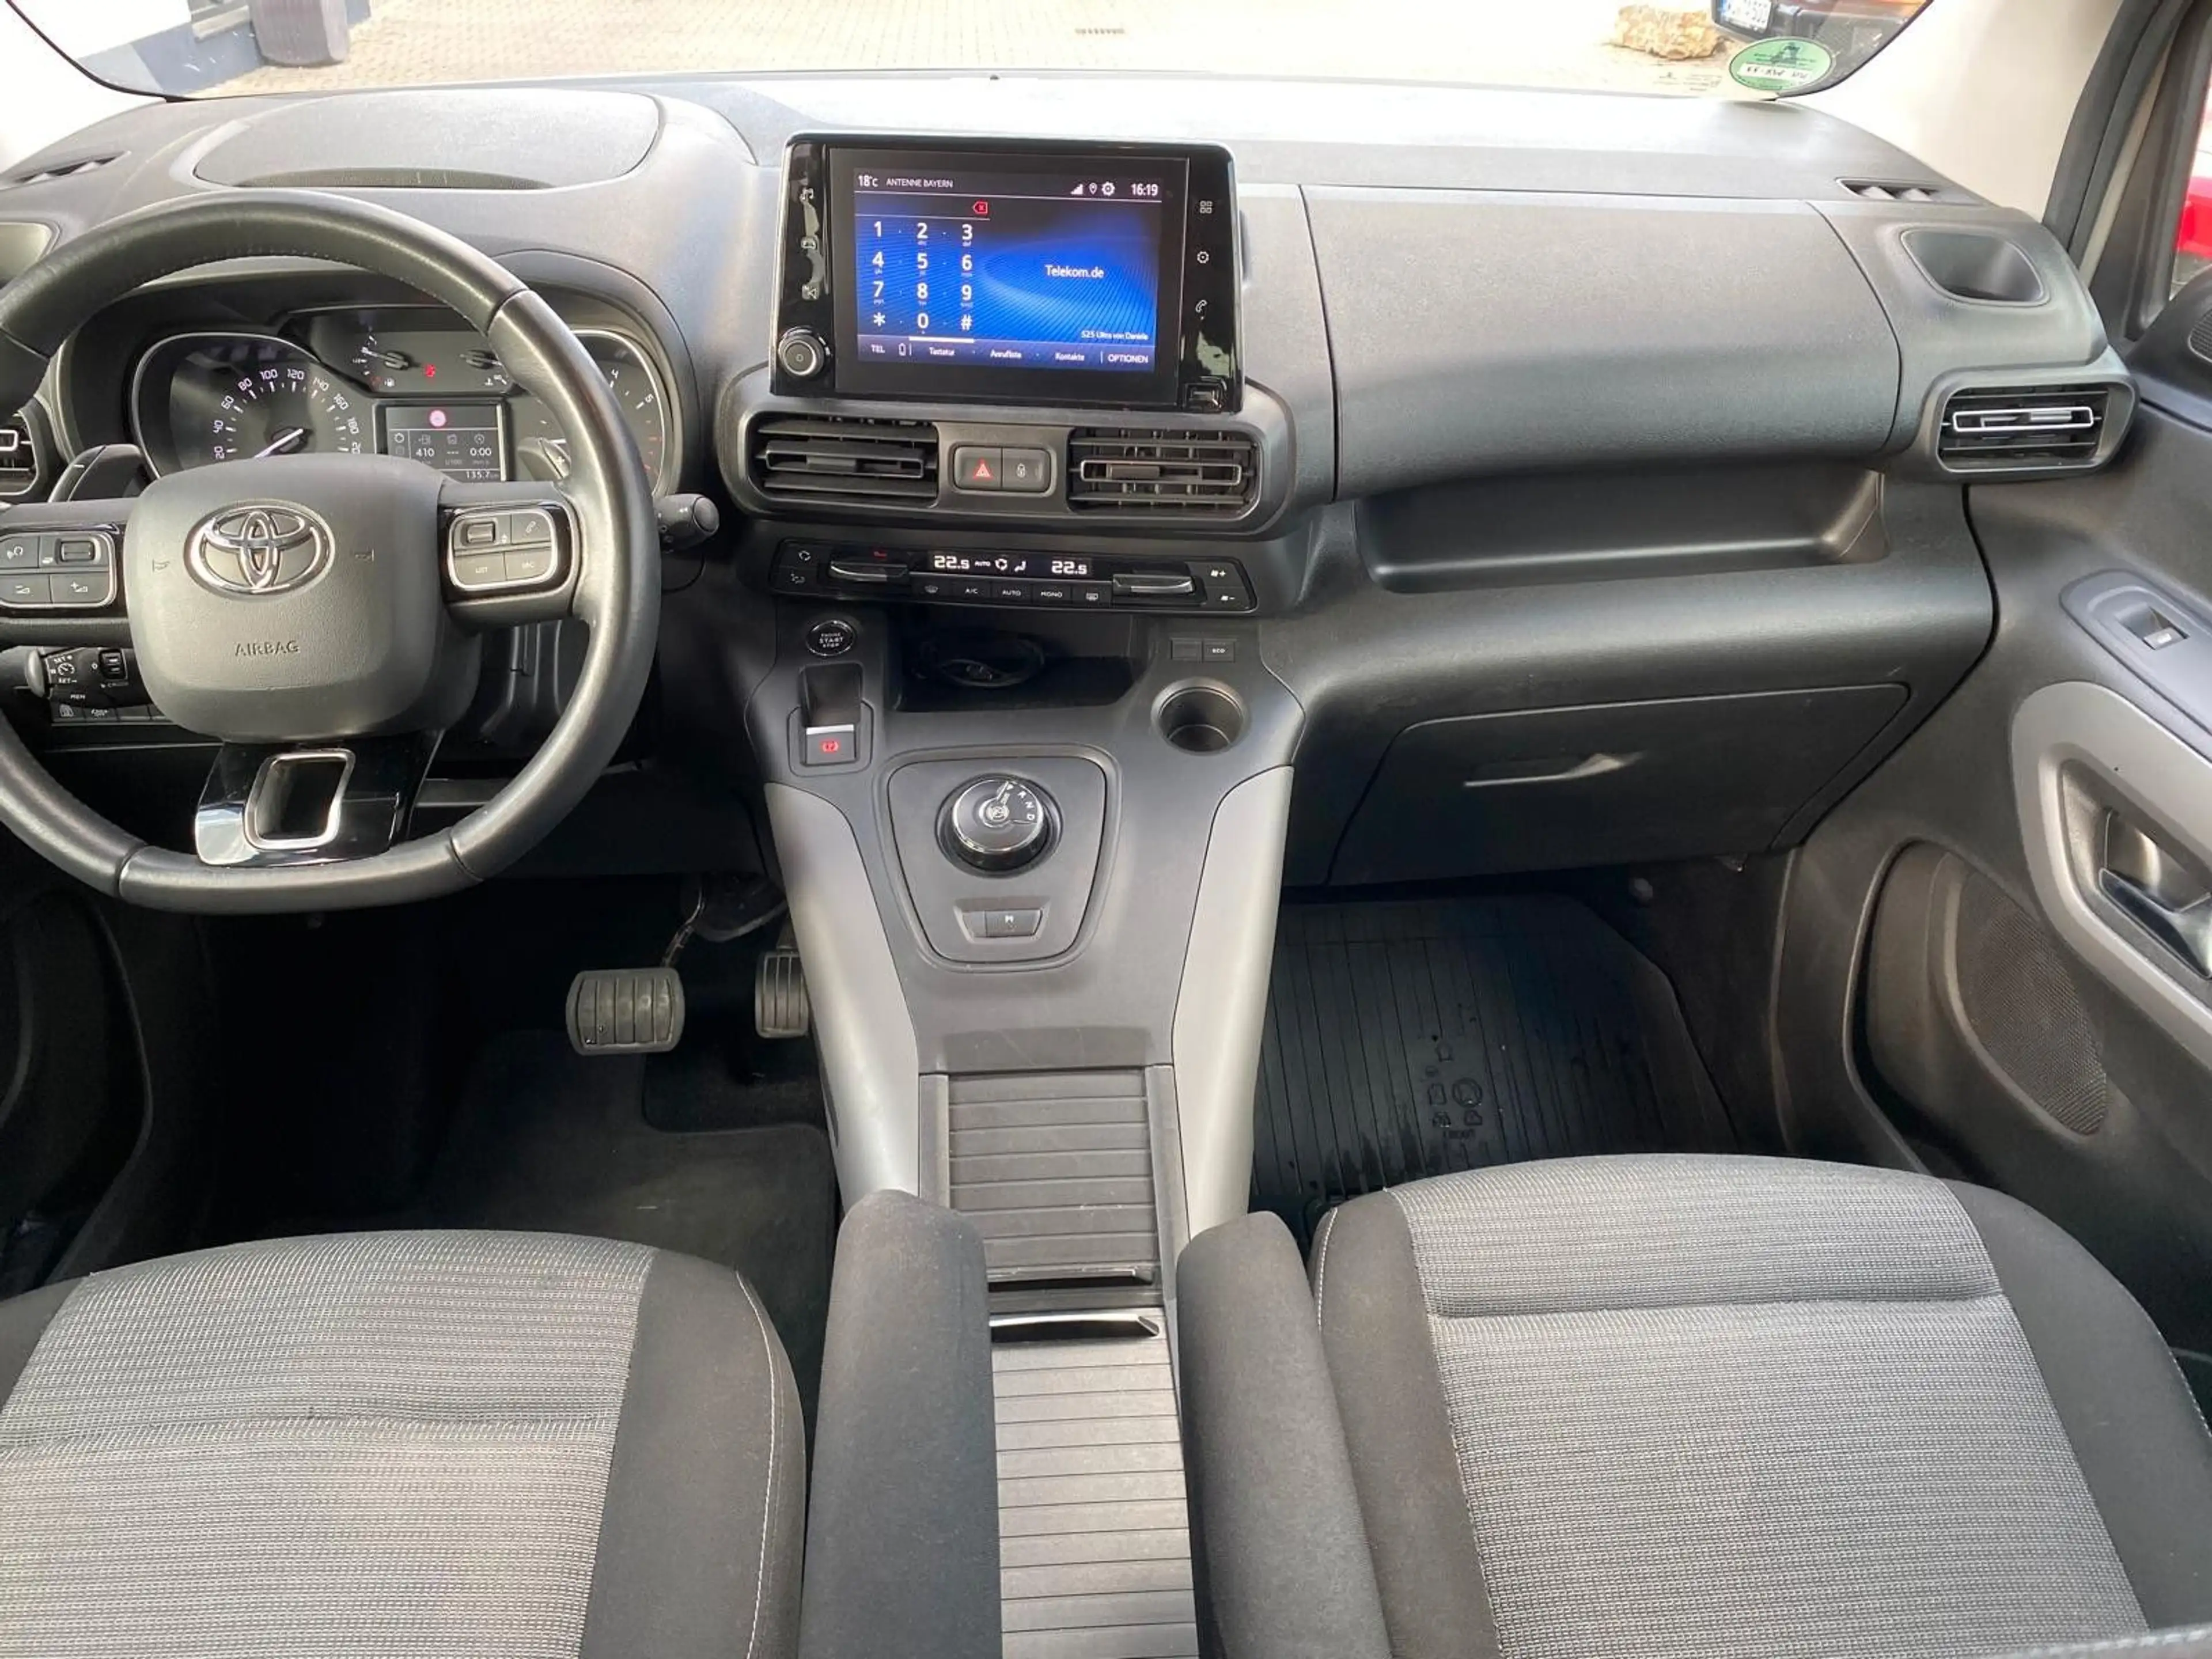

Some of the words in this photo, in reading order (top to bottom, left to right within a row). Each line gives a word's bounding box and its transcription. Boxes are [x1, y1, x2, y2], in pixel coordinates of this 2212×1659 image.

[886, 178, 922, 187] ANTENNE
[923, 179, 953, 188] BAYERN
[1131, 183, 1158, 196] 16:19
[873, 221, 882, 237] 1
[917, 222, 928, 238] 2
[962, 224, 973, 240] 3
[872, 251, 884, 268] 4
[917, 252, 928, 269] 5
[962, 255, 972, 271] 6
[1046, 264, 1104, 278] Telekom.de
[873, 281, 884, 297] 7
[917, 282, 928, 299] 8
[961, 285, 972, 301] 9
[871, 344, 885, 353] TEL
[929, 347, 955, 356] Tastatur
[1055, 353, 1085, 362] Kontakte
[1108, 354, 1149, 363] OPTIONEN
[260, 369, 278, 380] 100
[287, 369, 305, 380] 120
[237, 377, 253, 391] 80
[313, 377, 329, 391] 140
[221, 395, 234, 410] 60
[334, 393, 349, 410] 160
[213, 420, 224, 434] 40
[347, 417, 359, 434] 180
[214, 446, 225, 459] 20
[416, 448, 435, 457] 410
[934, 555, 970, 570] 22.5
[1051, 560, 1087, 575] 22.5
[234, 640, 300, 657] AIRBAG
